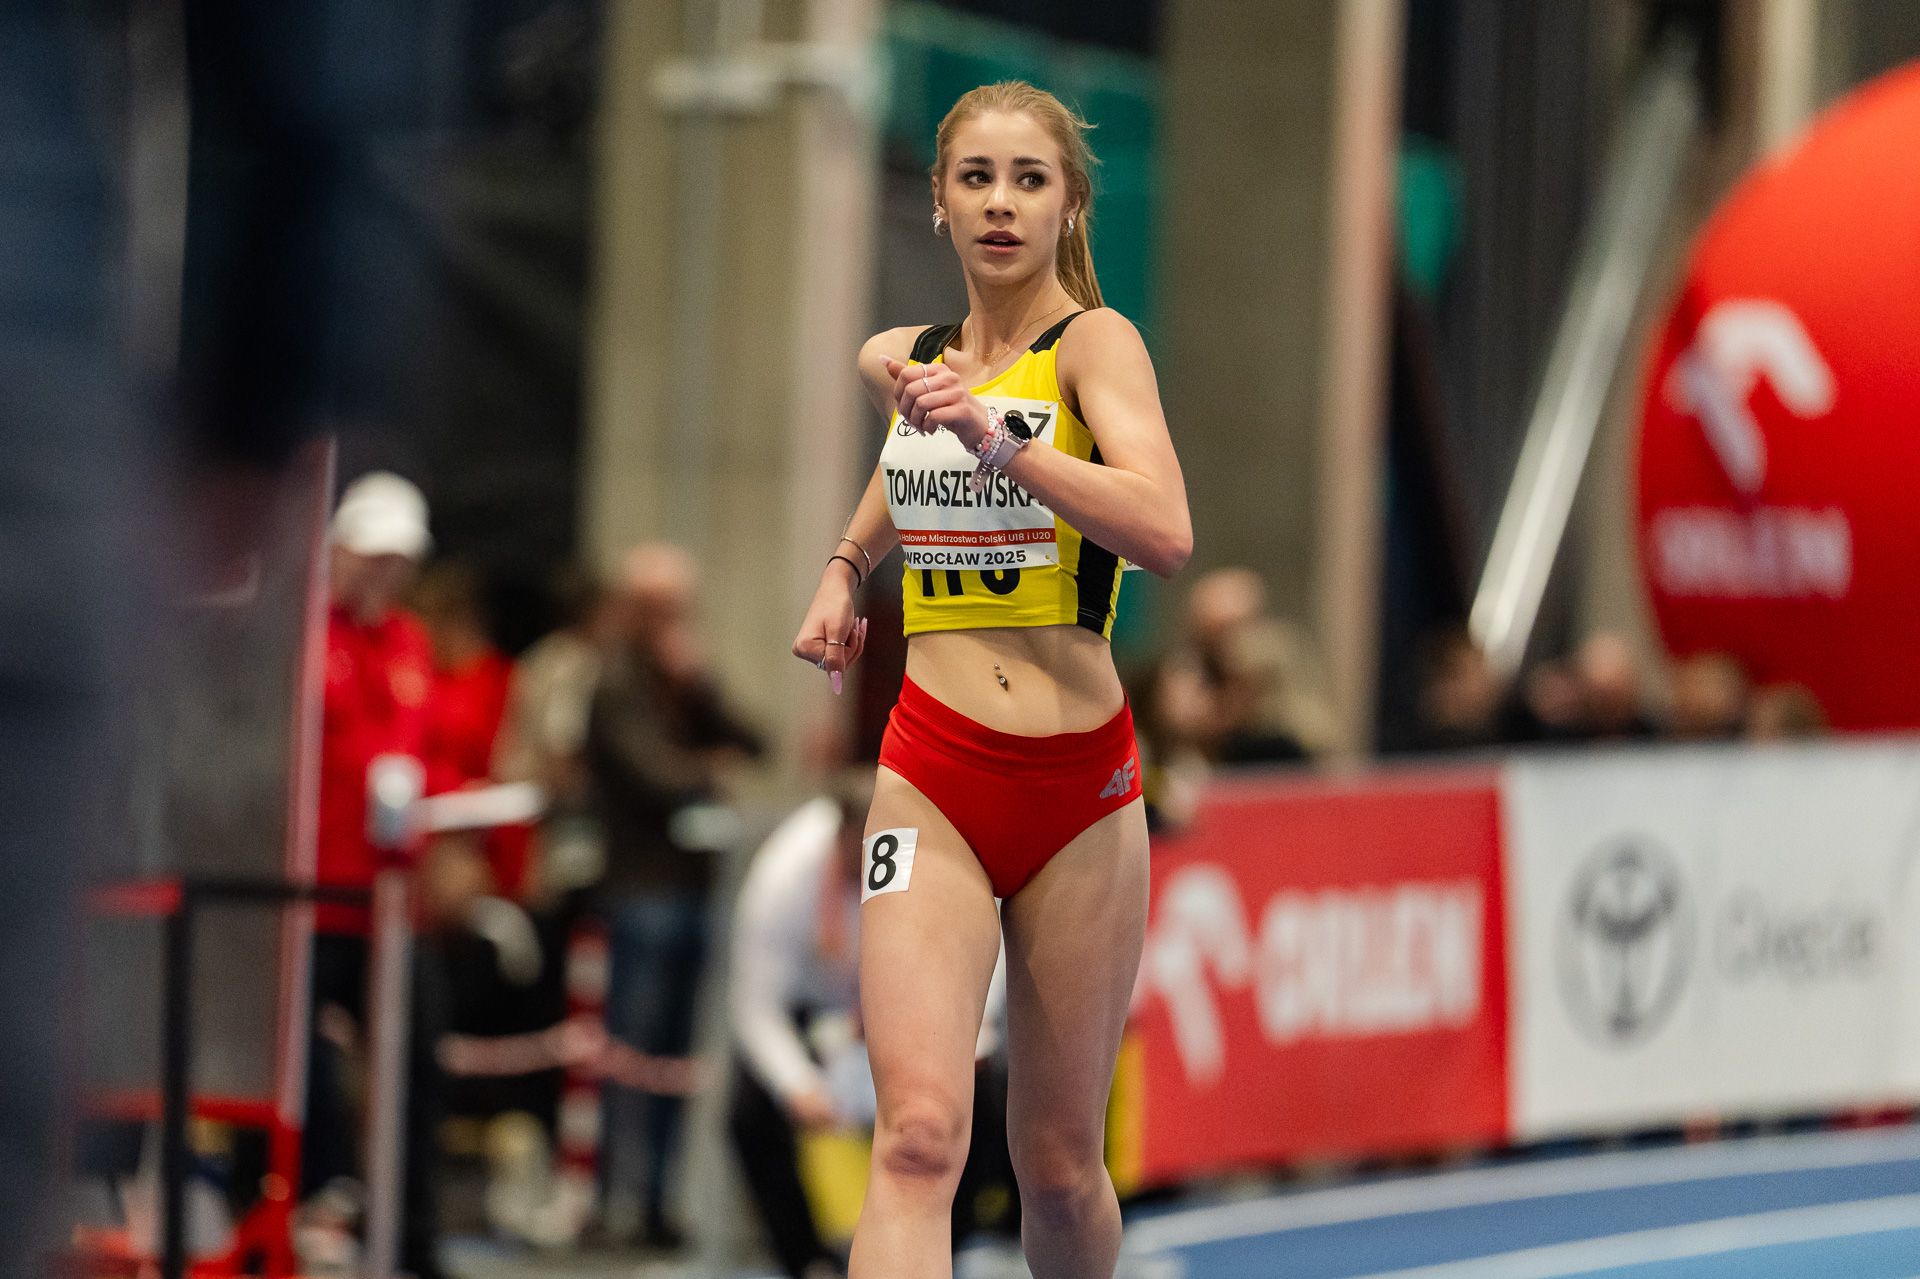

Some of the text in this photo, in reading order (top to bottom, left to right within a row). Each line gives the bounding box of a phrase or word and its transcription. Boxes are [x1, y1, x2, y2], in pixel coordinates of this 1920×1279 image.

[901, 531, 1051, 544] Halowe Mistrzostwa Polski U18 i U20
[984, 549, 1027, 565] 2025
[868, 834, 899, 891] 8
